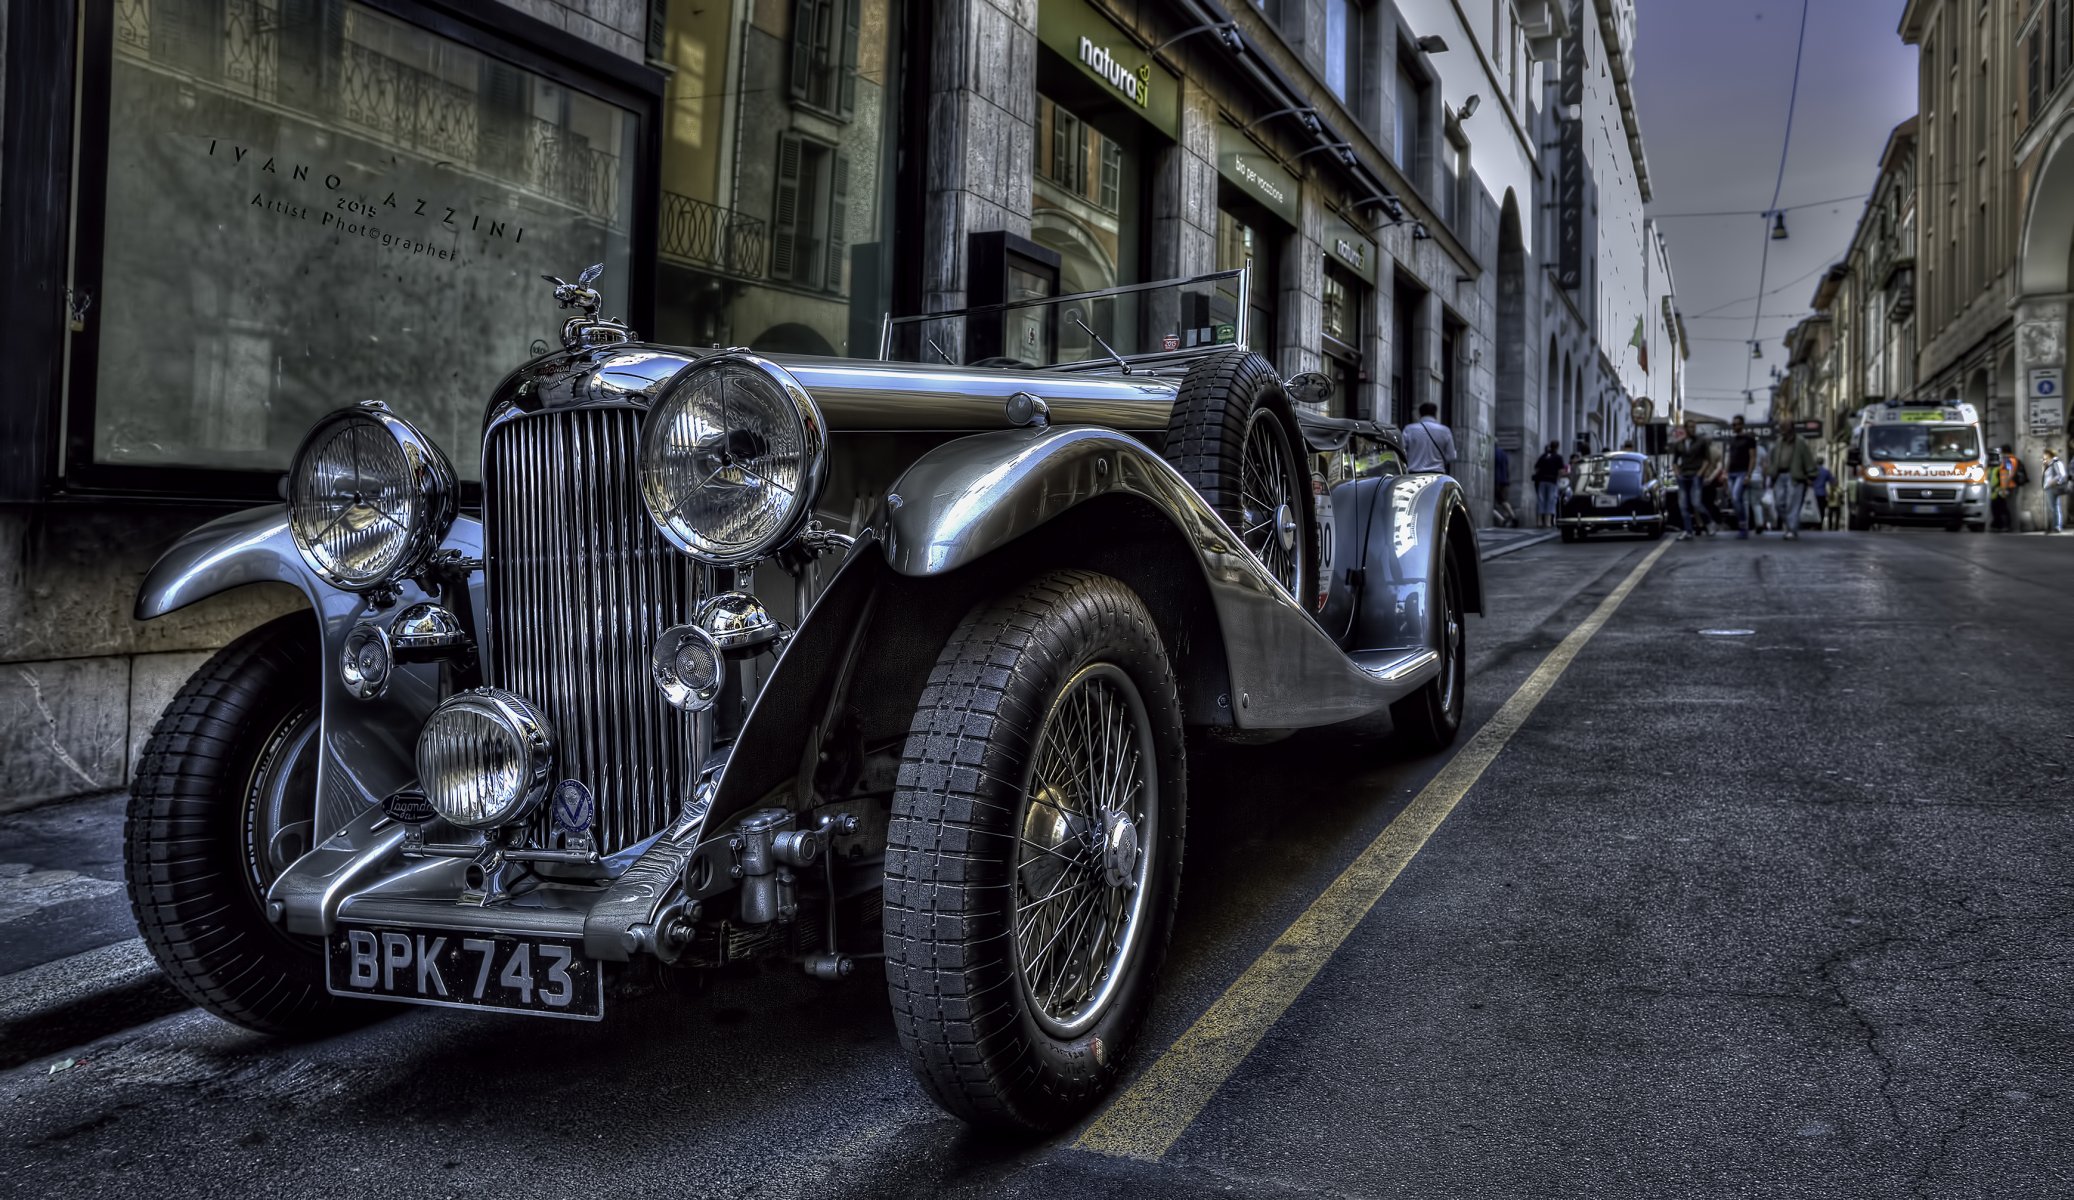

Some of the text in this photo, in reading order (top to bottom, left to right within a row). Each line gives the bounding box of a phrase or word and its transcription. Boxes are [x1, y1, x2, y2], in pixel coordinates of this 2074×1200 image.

[1235, 154, 1284, 204] bio per vocazione
[386, 795, 433, 814] Lagonda
[348, 929, 573, 1007] BPK 743
